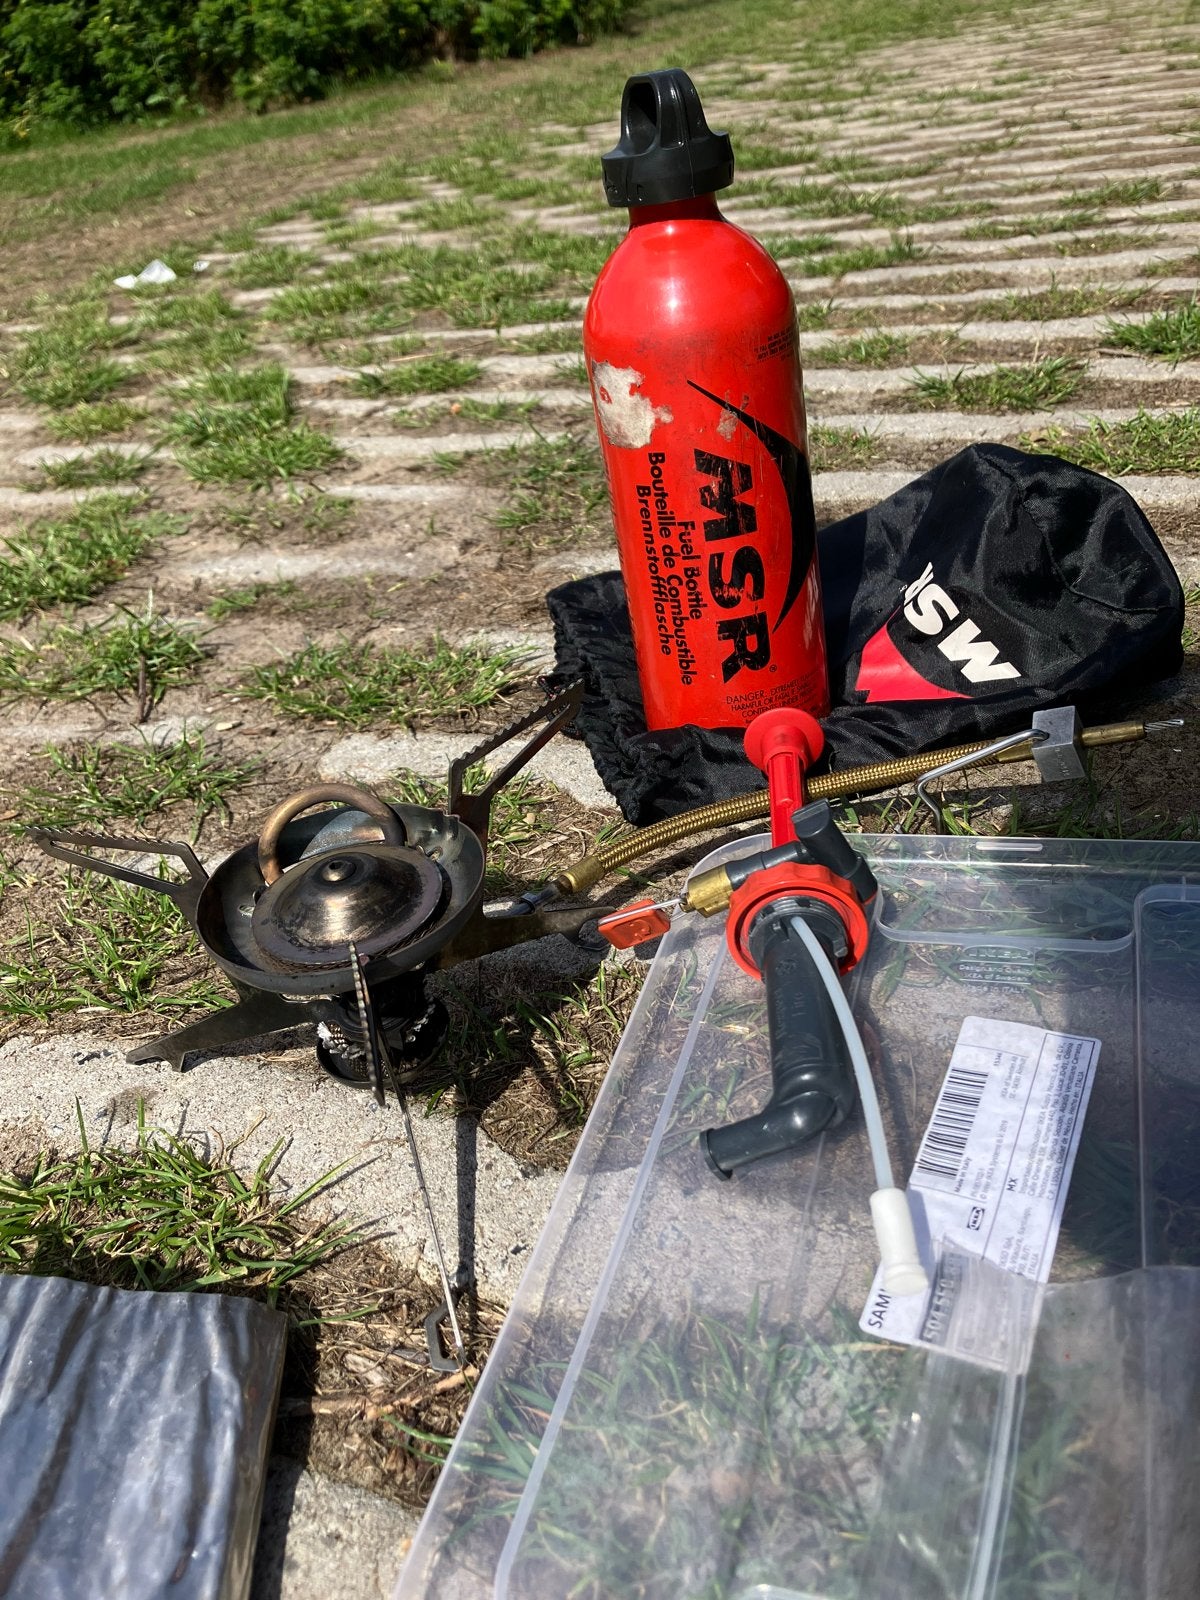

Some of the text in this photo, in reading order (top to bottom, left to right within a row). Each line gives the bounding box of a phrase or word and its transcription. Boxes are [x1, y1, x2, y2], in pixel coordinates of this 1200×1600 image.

[648, 452, 698, 685] Bouteille de Combustible
[677, 521, 708, 620] Fuel Bottle
[694, 449, 770, 683] MSR
[731, 698, 762, 711] HARMFUL
[1006, 1176, 1018, 1192] MX
[970, 1207, 981, 1228] IKEA
